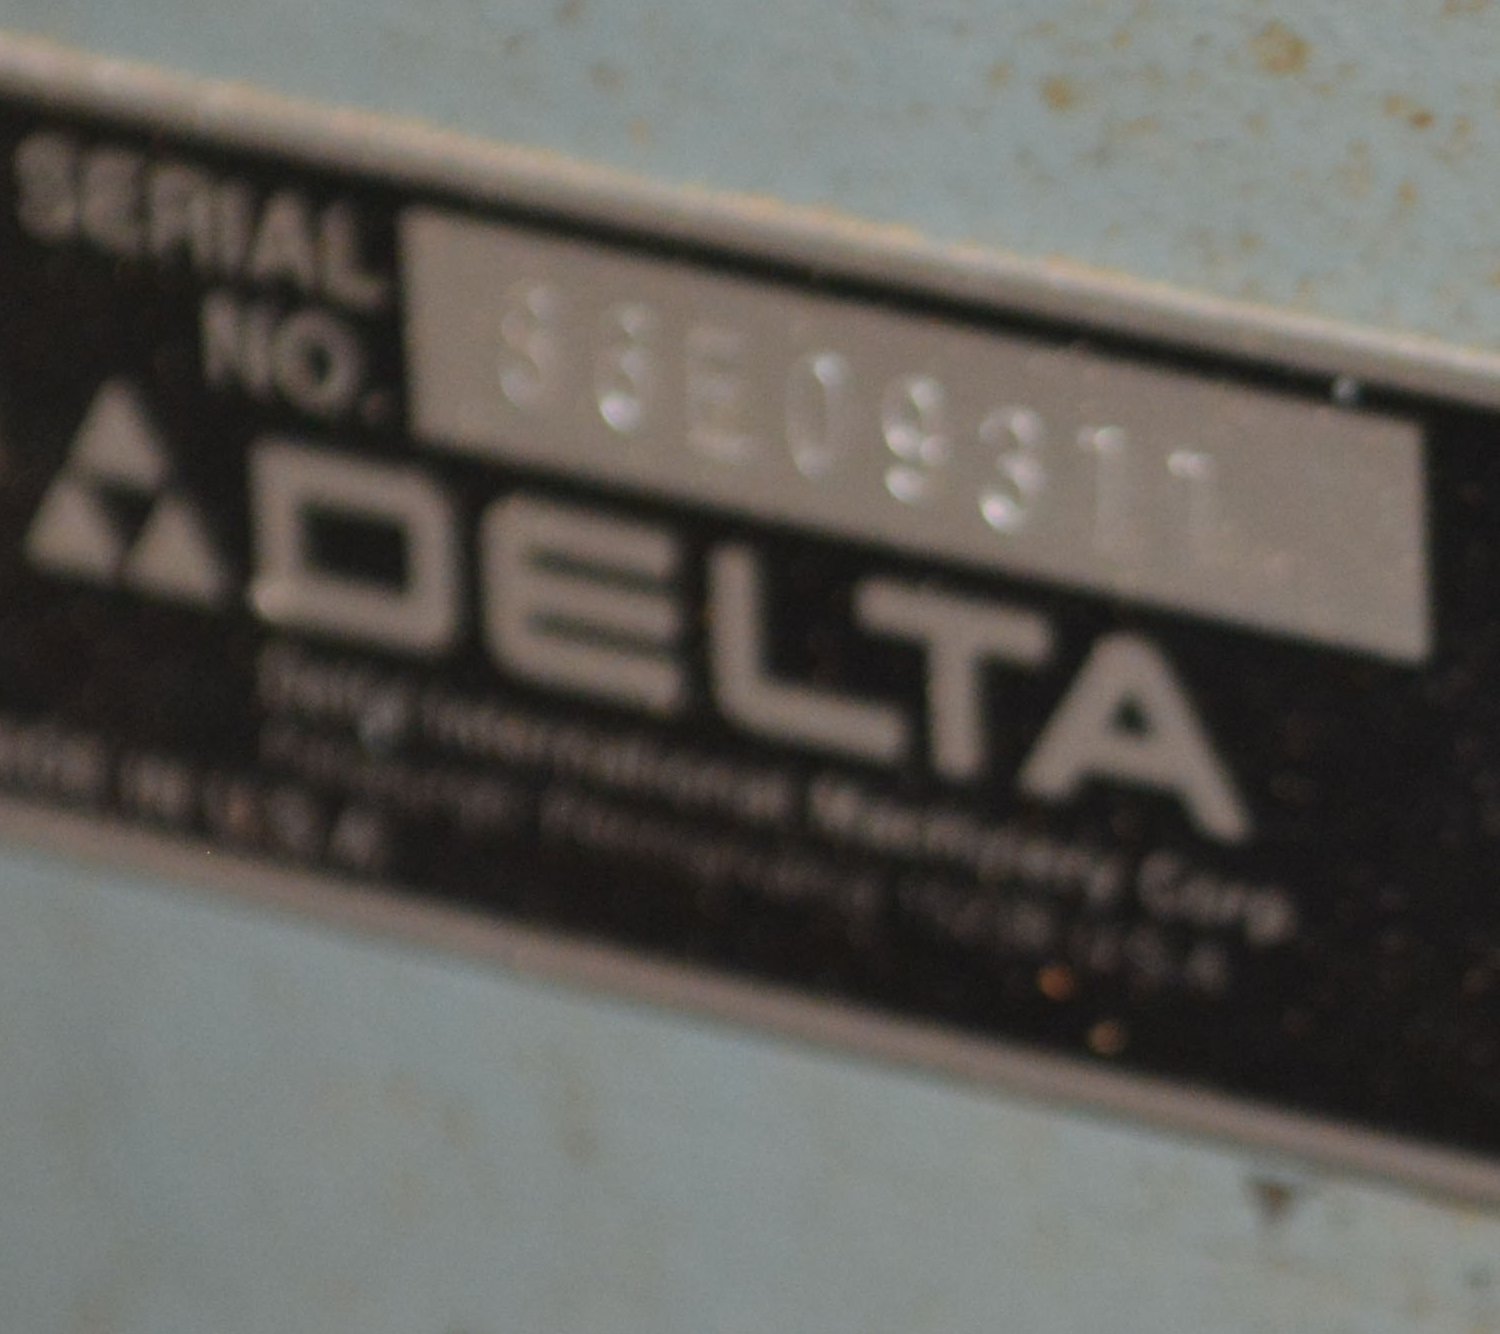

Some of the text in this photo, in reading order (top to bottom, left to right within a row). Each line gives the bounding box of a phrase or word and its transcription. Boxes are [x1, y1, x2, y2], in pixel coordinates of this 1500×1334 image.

[12, 130, 390, 312] SERIAL
[200, 287, 390, 427] NO.
[248, 435, 1258, 849] DELTA
